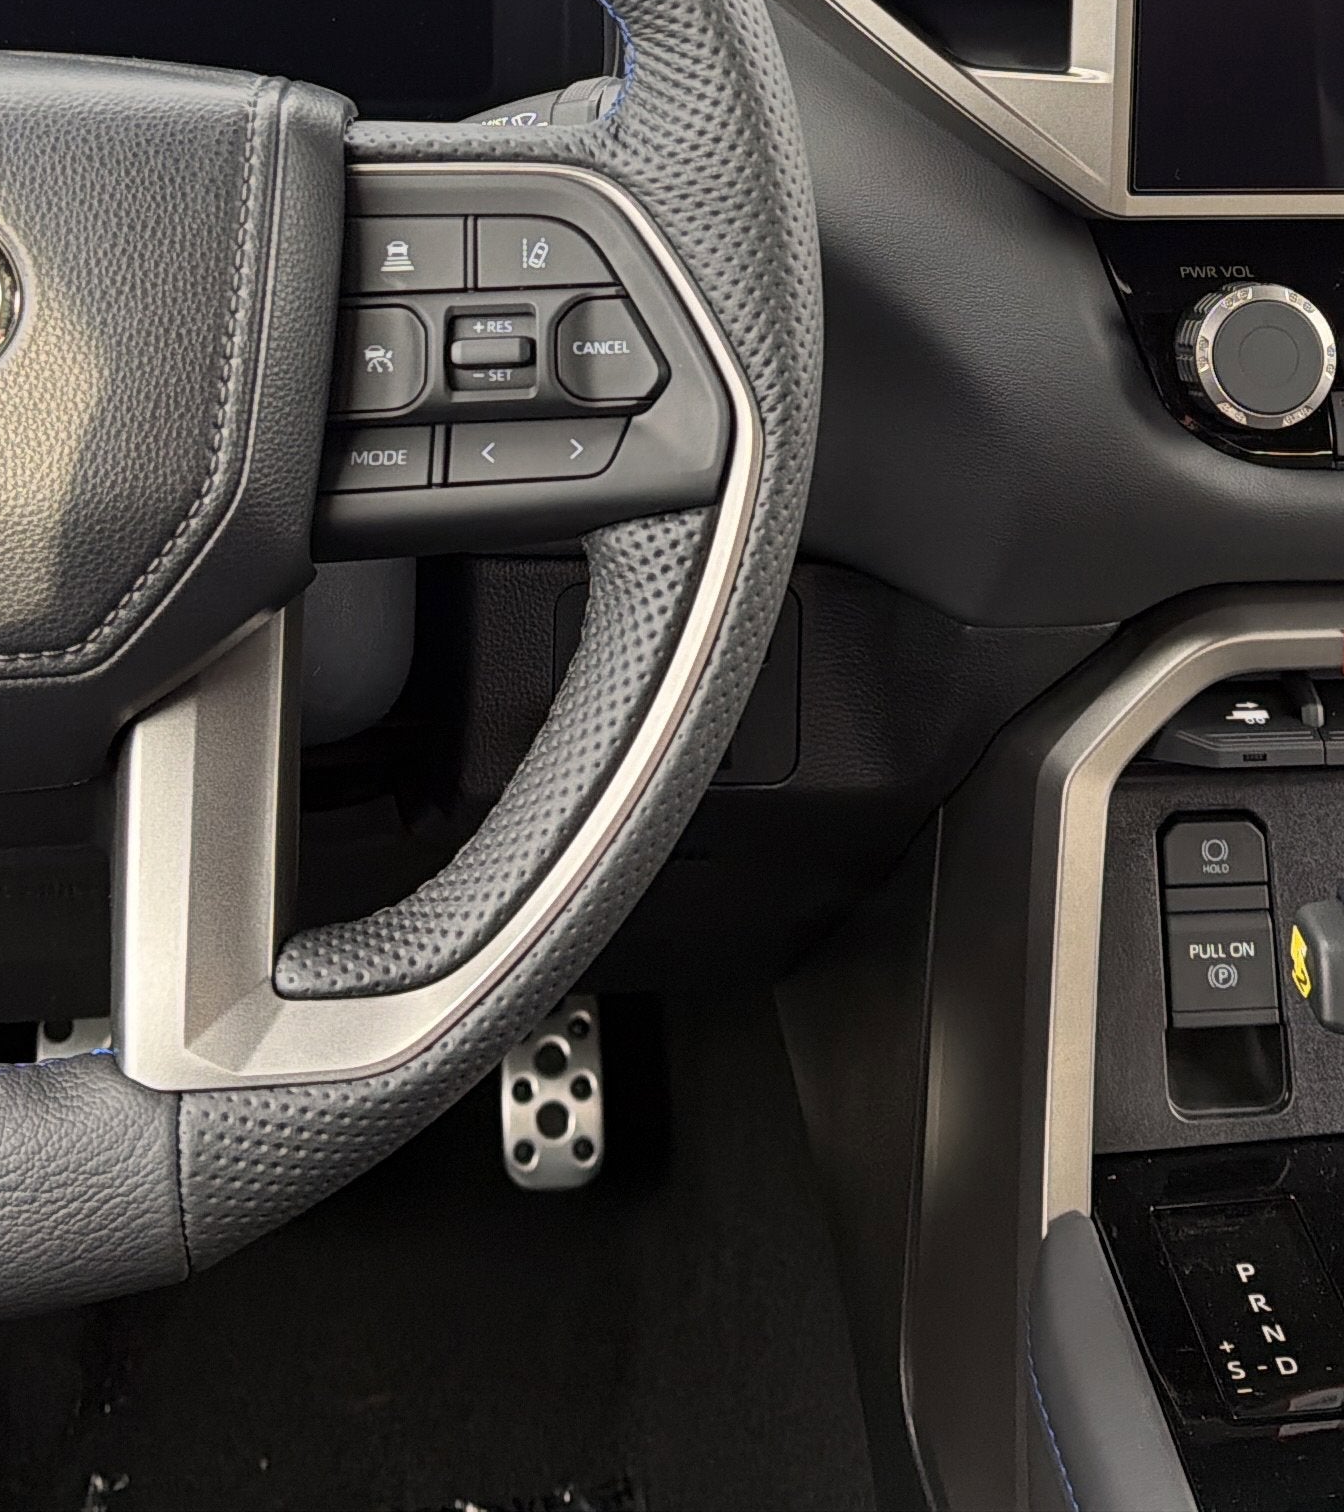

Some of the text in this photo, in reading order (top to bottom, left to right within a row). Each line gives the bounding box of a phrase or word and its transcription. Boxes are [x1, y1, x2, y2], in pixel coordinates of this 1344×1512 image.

[1180, 266, 1254, 279] PWR VOL
[573, 341, 630, 355] CANCEL
[351, 450, 407, 466] MODE
[1202, 863, 1230, 874] HOLD
[1189, 942, 1255, 959] PULL ON
[1236, 1263, 1255, 1283] P
[1247, 1293, 1273, 1313] R
[1261, 1324, 1287, 1343] N
